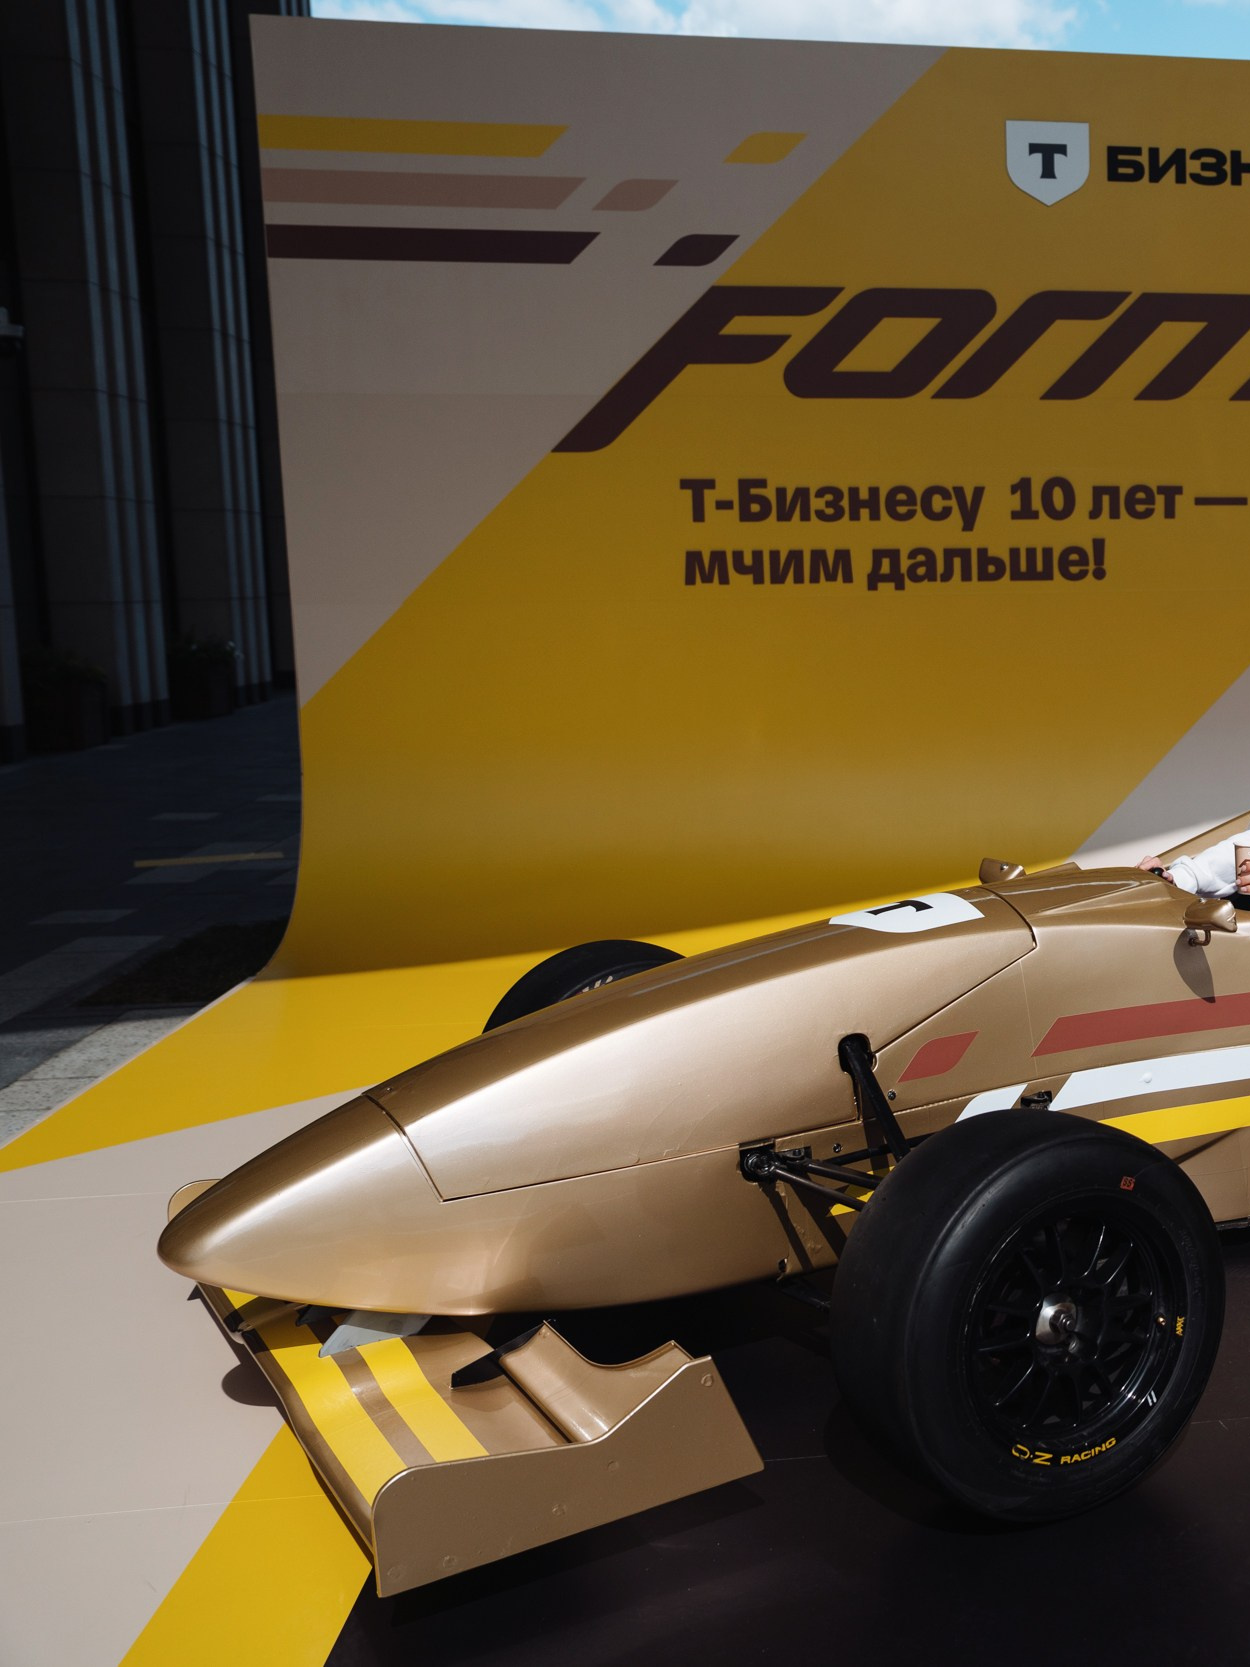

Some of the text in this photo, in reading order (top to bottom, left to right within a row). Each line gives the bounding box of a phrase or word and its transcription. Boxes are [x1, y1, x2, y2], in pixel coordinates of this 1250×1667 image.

[679, 478, 986, 532] Т-Бизнесу
[1010, 476, 1076, 521] 10
[1088, 484, 1184, 520] лет
[684, 537, 1107, 591] мчим дальше!
[1060, 1437, 1117, 1465] RACING
